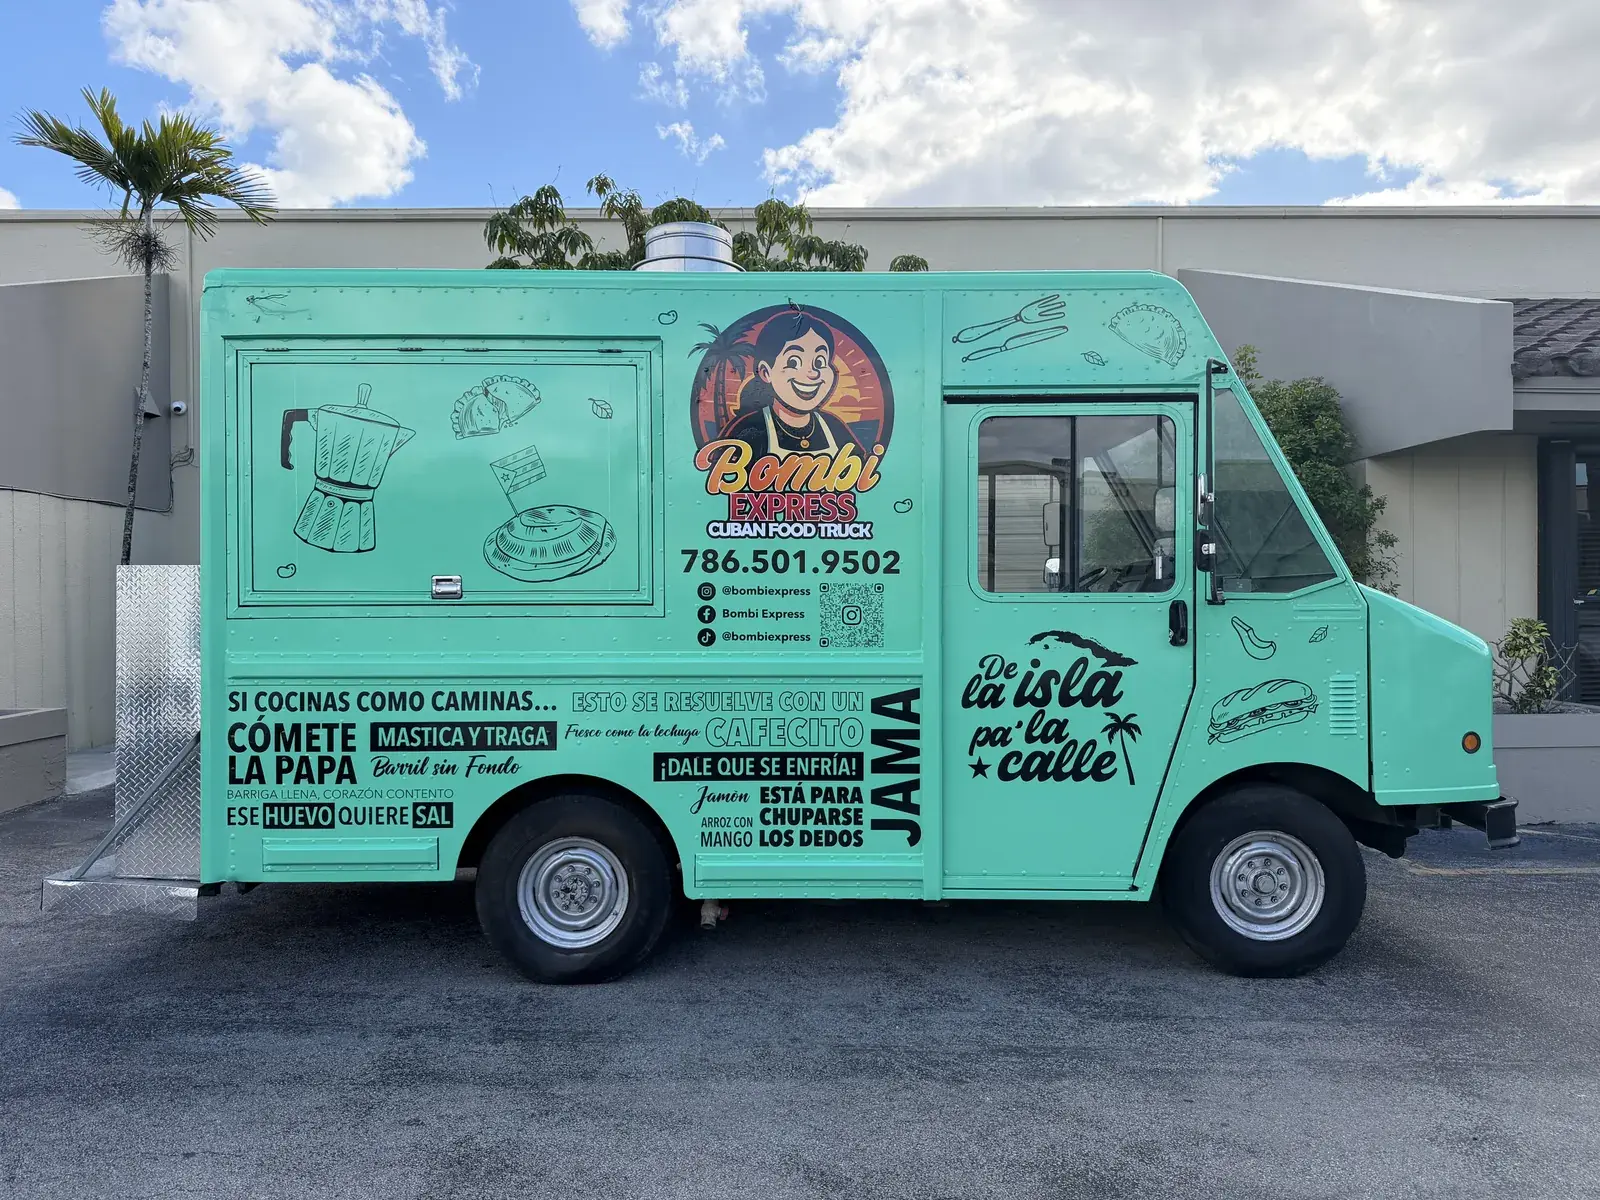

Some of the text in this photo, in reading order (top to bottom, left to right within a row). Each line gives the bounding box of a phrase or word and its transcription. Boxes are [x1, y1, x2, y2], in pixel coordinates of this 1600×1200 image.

[695, 439, 886, 494] Bombi
[729, 493, 856, 522] EXPRESS
[708, 523, 872, 538] CUBAN FOOD TRUCK
[681, 549, 900, 574] 786.501.9502
[722, 585, 811, 598] @bombiexpress
[723, 608, 805, 620] Bombi Express
[722, 631, 811, 643] @bombiexpress
[978, 653, 1017, 680] De
[961, 656, 1124, 709] la isla
[228, 690, 557, 712] SI COCINAS COMO CAMINAS...
[573, 690, 864, 712] ESTO SE RESUELVE CON UN
[228, 714, 357, 753] CÓMETE
[379, 725, 549, 746] MASTICA Y TRAGA
[565, 723, 701, 745] Fresco como la lechuga
[705, 716, 865, 747] CAFECITO
[1024, 708, 1069, 745] la
[229, 755, 358, 784] LA PAPA
[371, 754, 522, 778] Barril sin Fondo
[662, 752, 856, 780] ¡DALE QUE SE ENFRÍA!
[870, 686, 922, 848] JAMA
[997, 739, 1118, 782] calle
[227, 786, 454, 800] BARRIGA LLENA, CORAZÓN CONTENTO
[760, 781, 864, 804] ESTÁ PARA
[228, 805, 451, 825] ESE HUEVO QUIERE SAL
[701, 816, 754, 828] ARROZ CON
[760, 807, 864, 825] CHUPARSE
[701, 830, 753, 847] MANGO
[760, 829, 864, 847] LOS DEDOS
